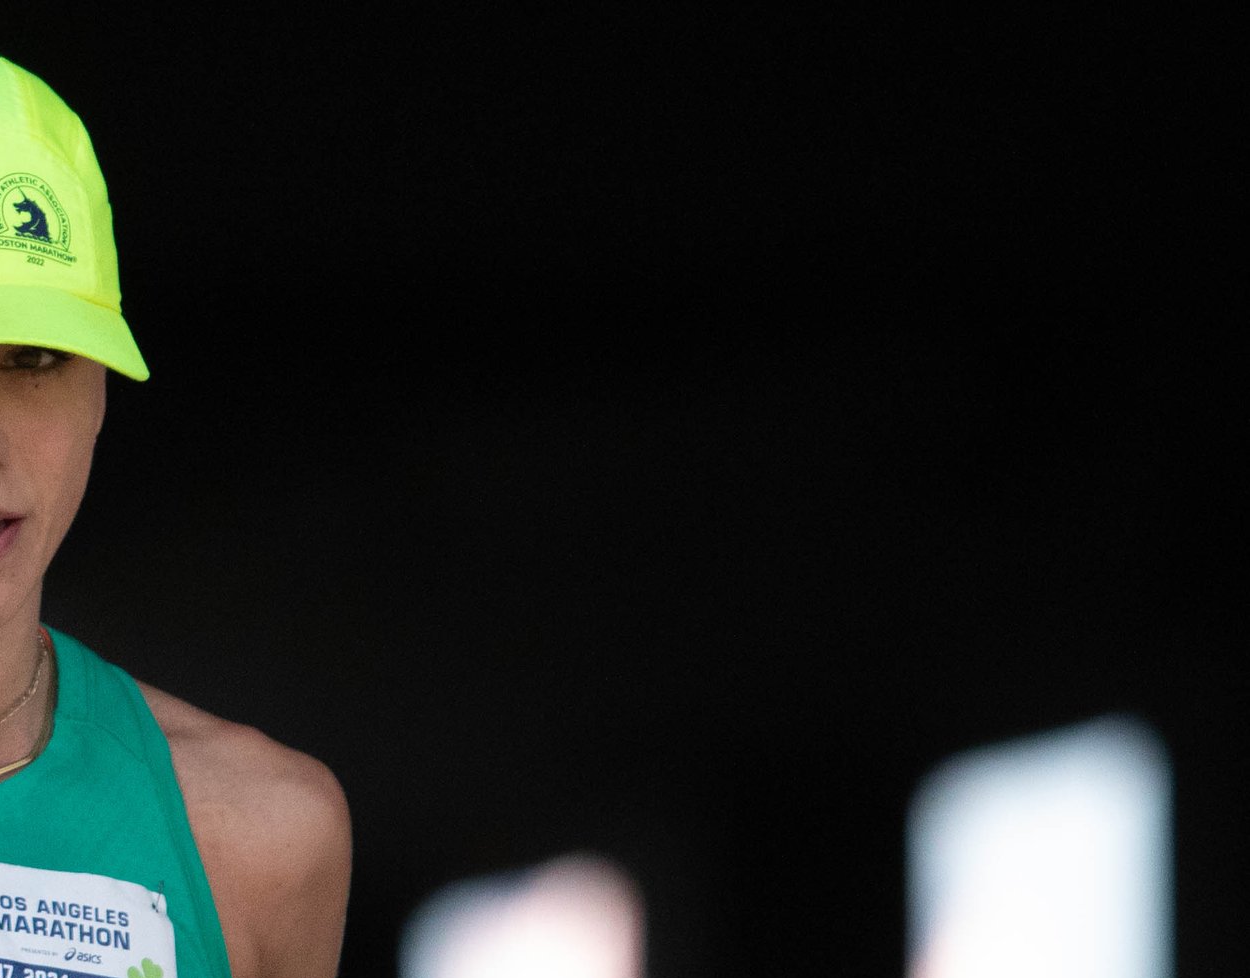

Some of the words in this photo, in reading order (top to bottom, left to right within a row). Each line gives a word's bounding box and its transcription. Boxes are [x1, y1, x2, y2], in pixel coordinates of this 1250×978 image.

[0, 176, 38, 193] ATHLETIC
[39, 184, 69, 246] ASSOCIATION
[26, 255, 45, 266] 2022
[37, 899, 129, 927] ANGELES
